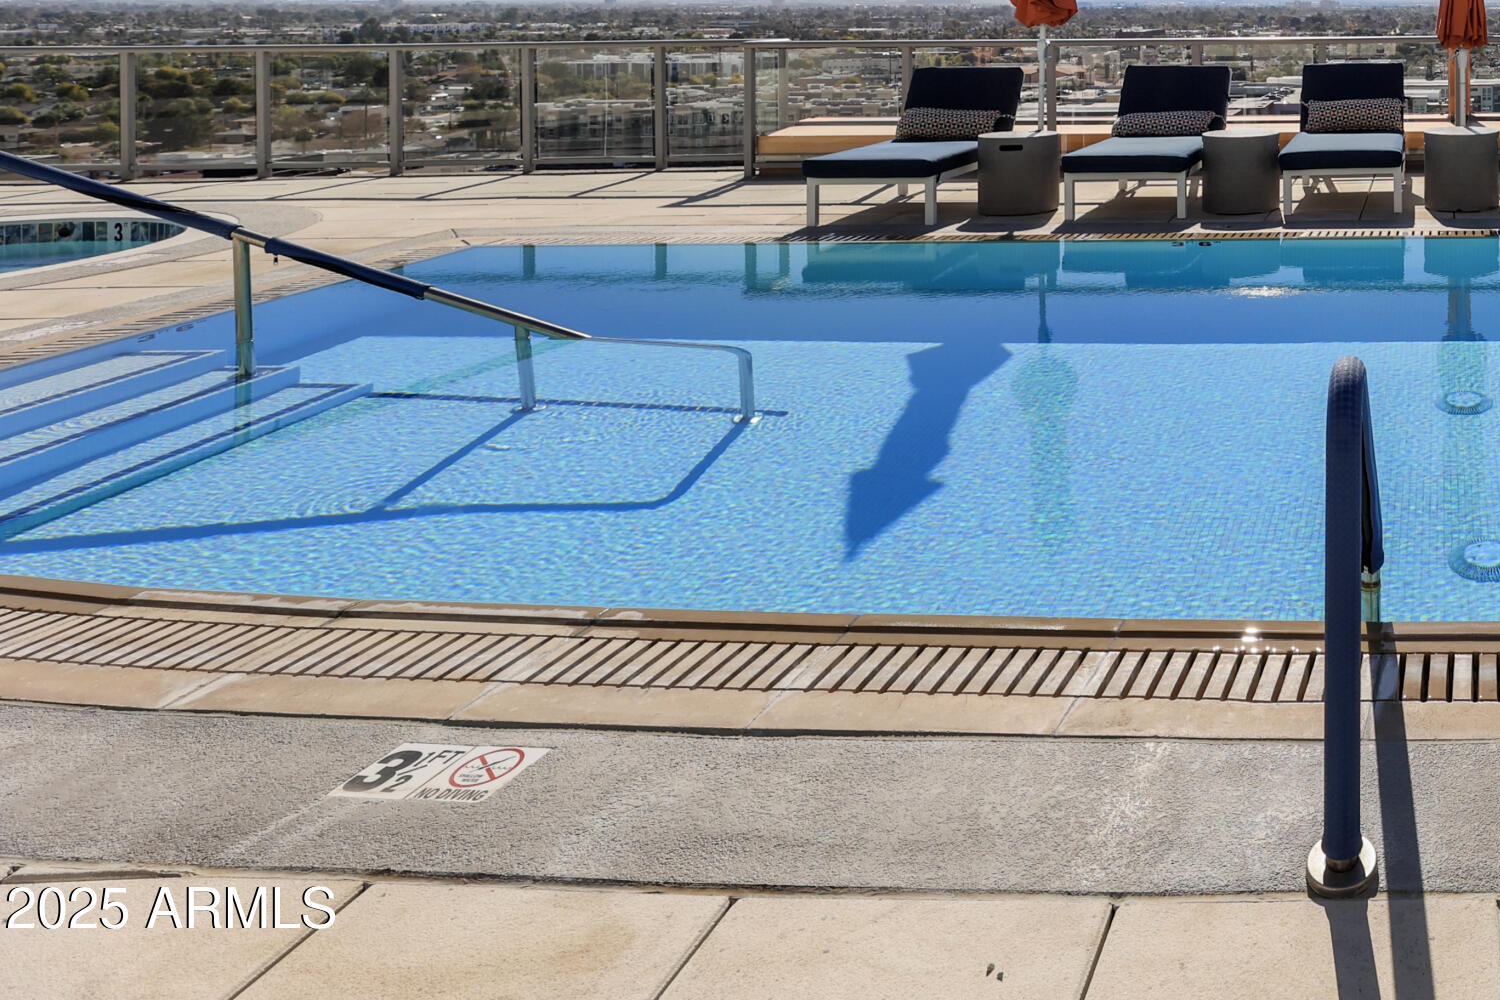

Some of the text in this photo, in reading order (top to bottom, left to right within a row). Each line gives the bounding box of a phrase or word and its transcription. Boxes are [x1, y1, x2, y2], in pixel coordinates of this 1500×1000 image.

[114, 222, 123, 242] 3
[428, 750, 466, 764] FT
[414, 788, 489, 801] NO DIVING
